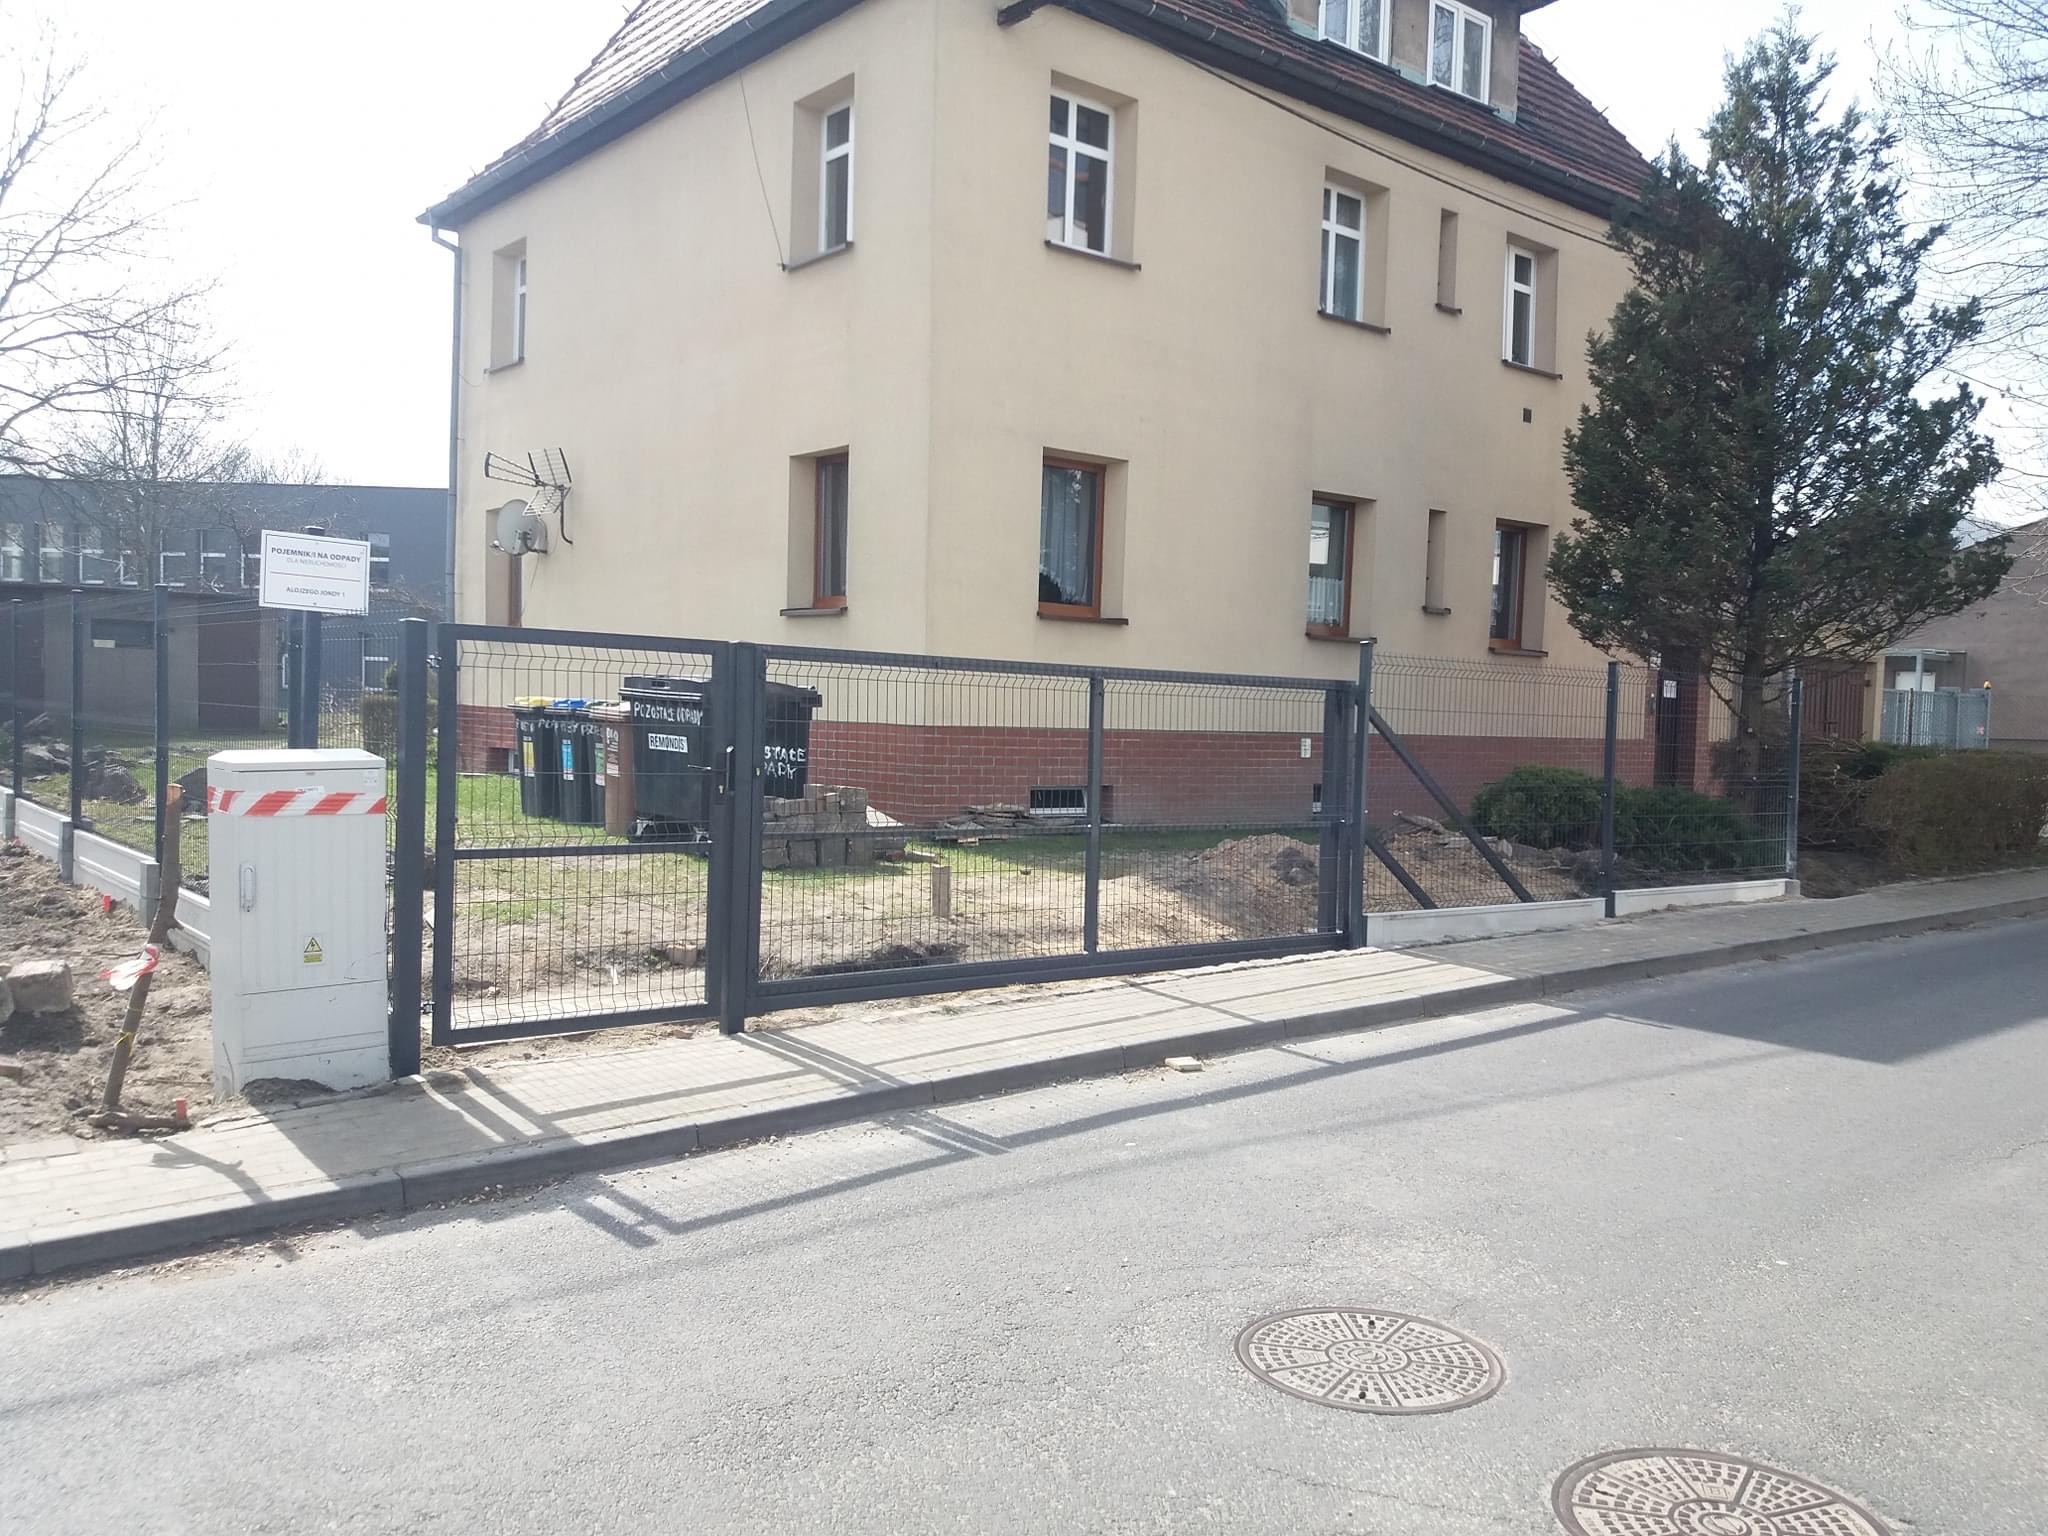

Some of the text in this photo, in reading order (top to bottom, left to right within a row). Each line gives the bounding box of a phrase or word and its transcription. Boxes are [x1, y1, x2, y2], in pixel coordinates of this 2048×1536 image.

[271, 547, 361, 563] POJEMNIK/I NA ODPADY
[649, 735, 686, 751] REMONDIS
